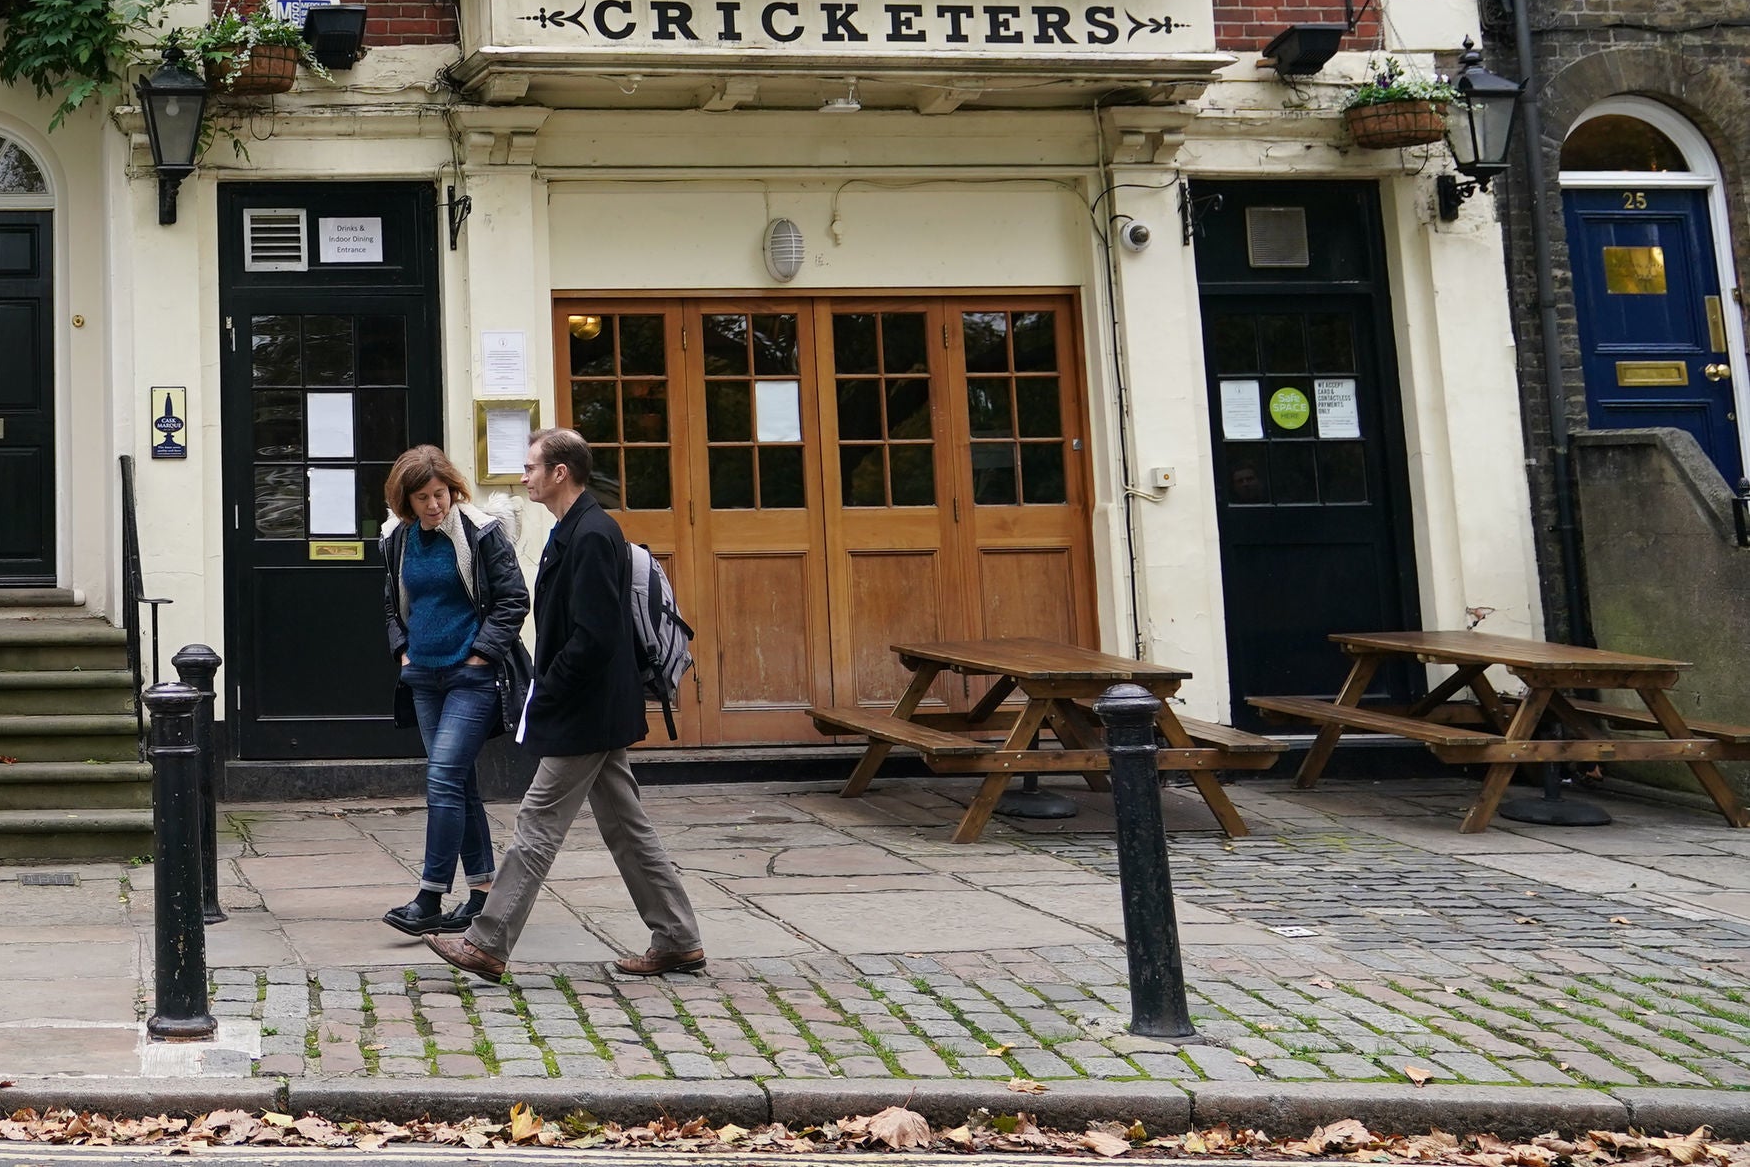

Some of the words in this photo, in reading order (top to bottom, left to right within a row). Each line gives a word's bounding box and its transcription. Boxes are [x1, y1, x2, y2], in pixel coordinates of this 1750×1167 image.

[593, 0, 1121, 44] CRICKETERS
[1622, 192, 1647, 209] 25
[1273, 403, 1307, 412] SPACE
